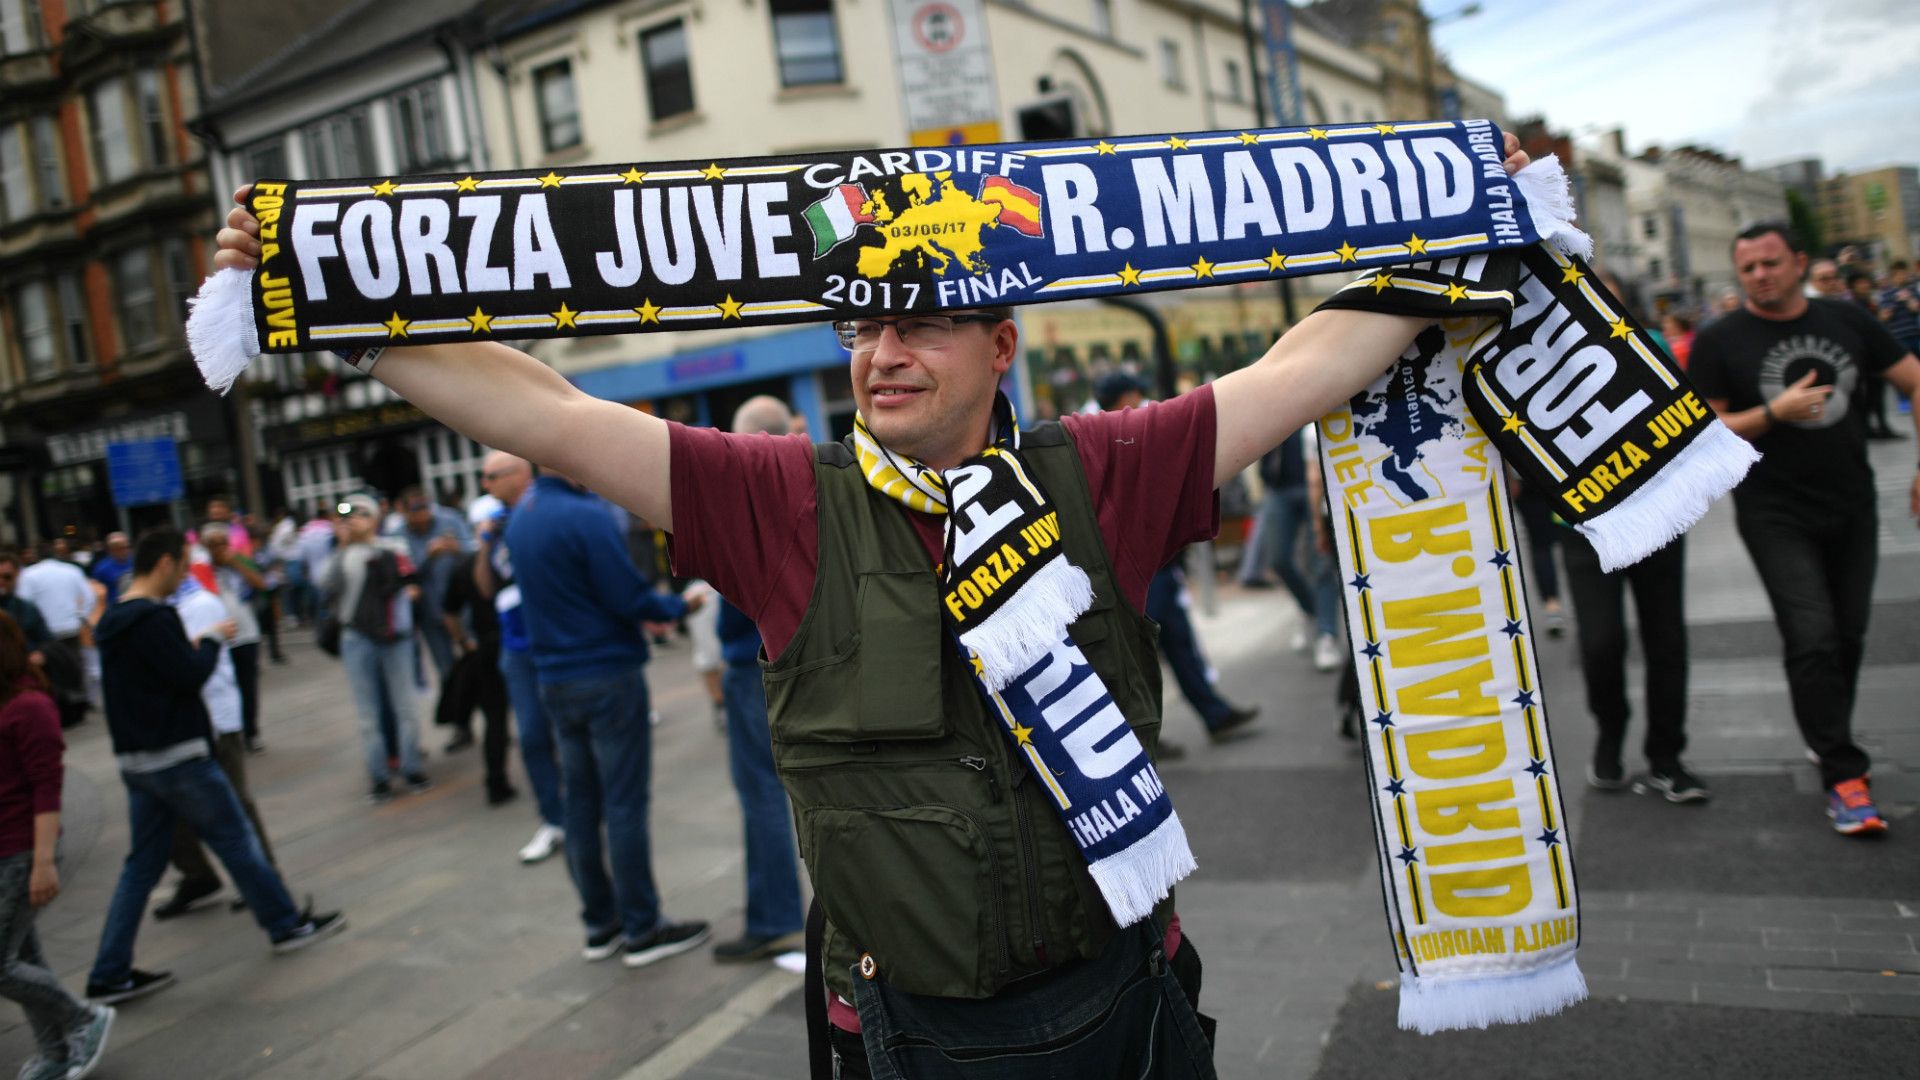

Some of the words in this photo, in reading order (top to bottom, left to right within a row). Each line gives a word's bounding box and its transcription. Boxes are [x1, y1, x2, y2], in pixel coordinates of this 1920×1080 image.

[803, 150, 1027, 189] CARDIFF
[1041, 136, 1475, 256] R.MADRID
[252, 183, 288, 265] FORZA
[291, 193, 572, 301] FORZA
[595, 181, 801, 288] JUVE
[890, 222, 967, 239] 03/06/17
[260, 271, 298, 348] JUVE
[821, 274, 921, 310] 2017
[937, 261, 1043, 308] FINAL
[1561, 440, 1651, 514] FORZA
[1646, 390, 1709, 449] JUVE
[945, 543, 1026, 622] FORZA
[1020, 511, 1061, 557] JUV
